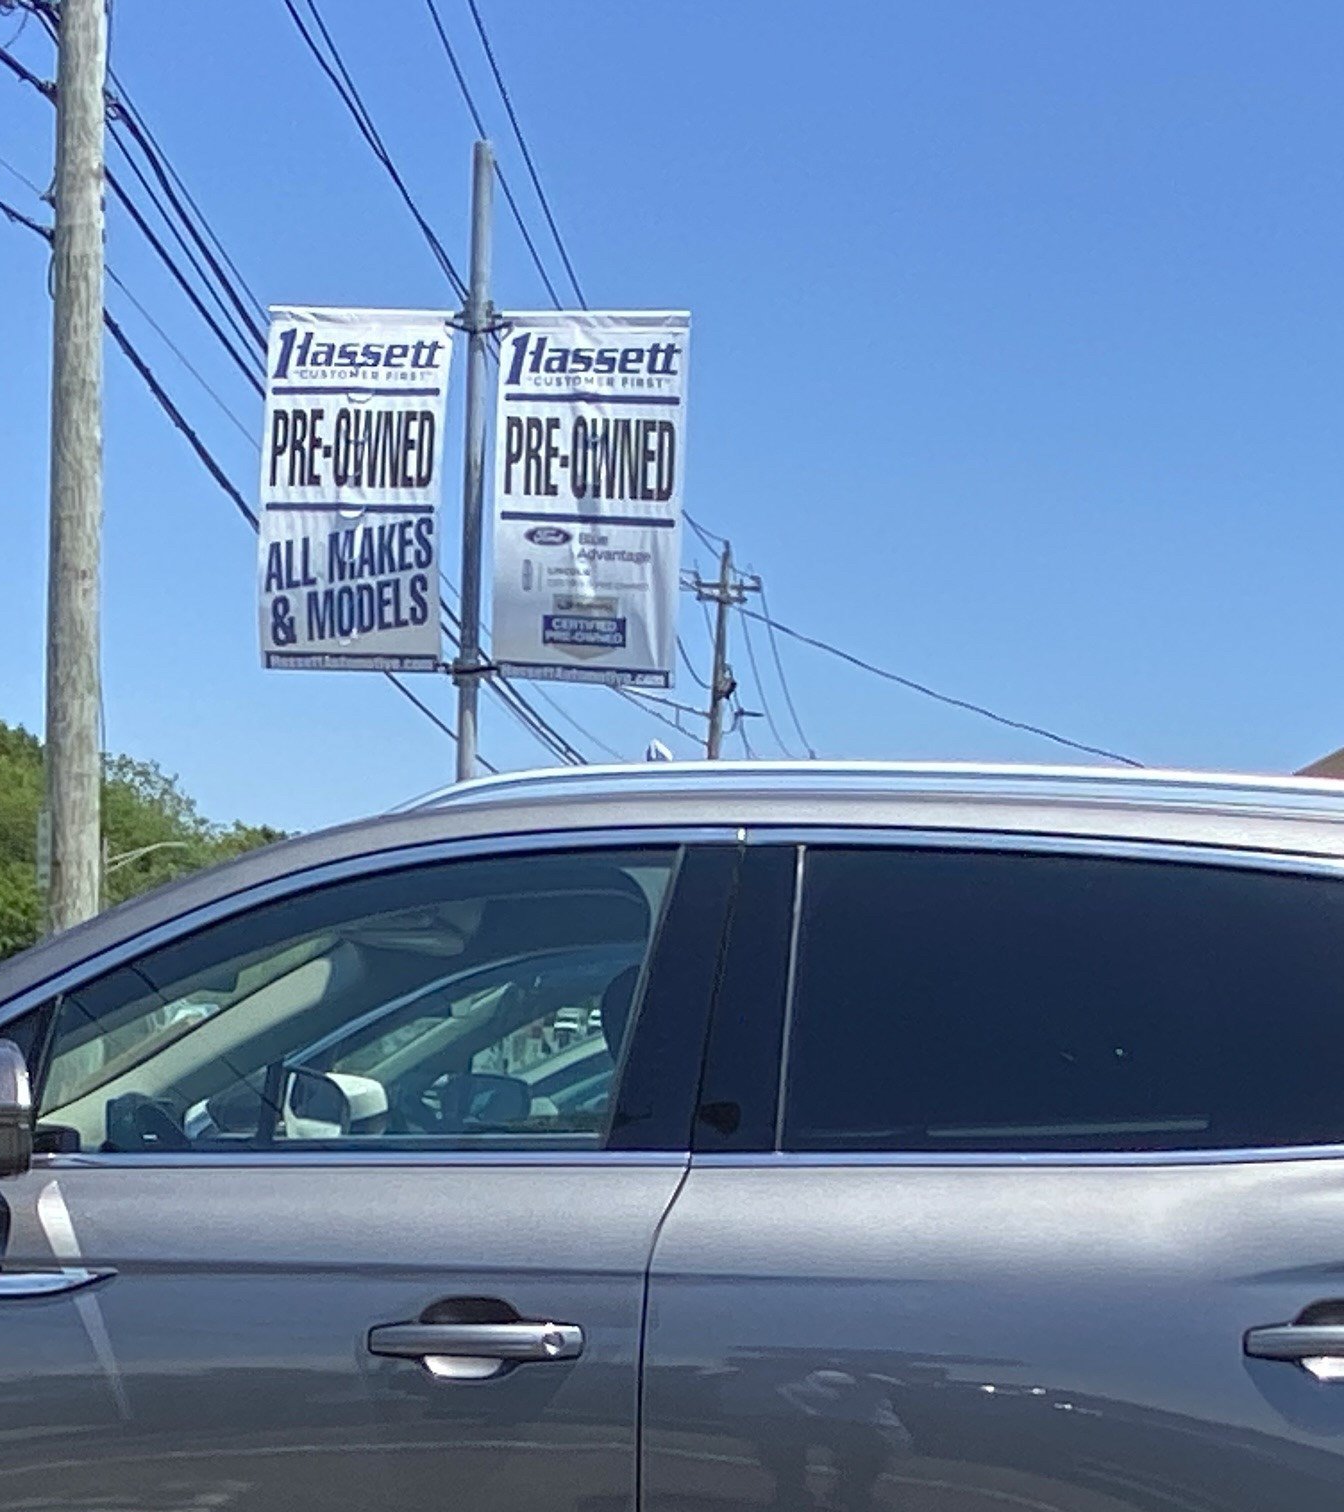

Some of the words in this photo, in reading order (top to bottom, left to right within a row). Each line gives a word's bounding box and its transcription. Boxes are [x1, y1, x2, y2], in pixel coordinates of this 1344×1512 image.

[270, 407, 435, 489] PRE-OWNED
[504, 415, 676, 502] PRE-OWNED
[265, 537, 317, 592] ALL
[328, 517, 434, 584] MAKES
[577, 549, 652, 565] Advantage
[271, 595, 298, 647] &
[307, 573, 429, 641] MODELS
